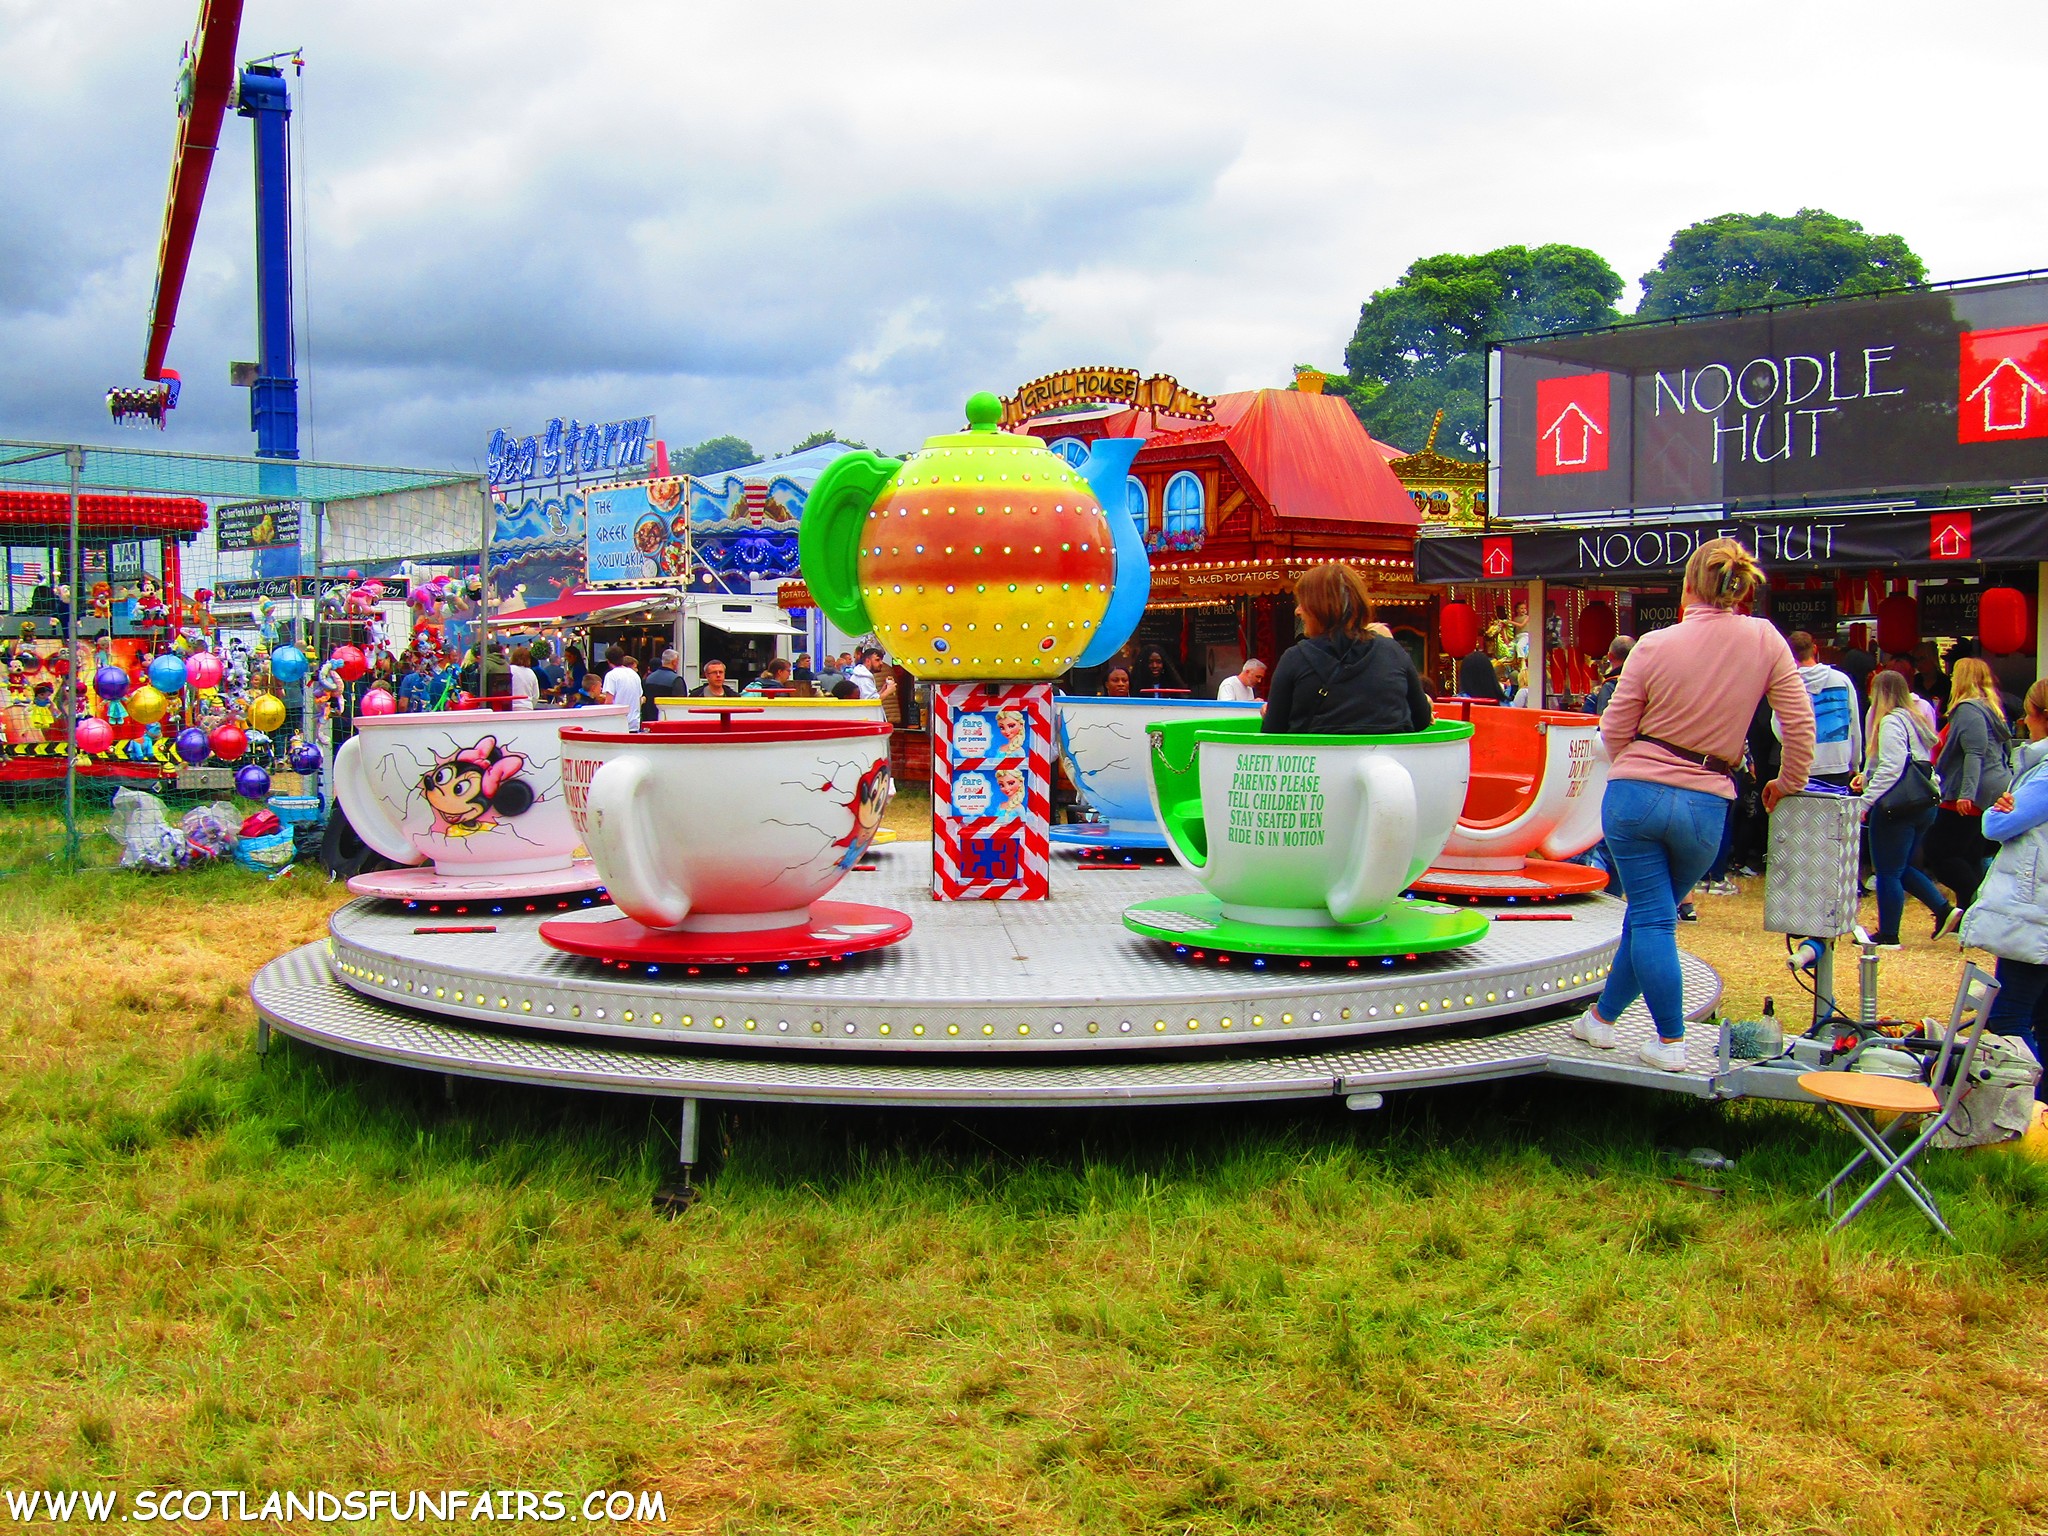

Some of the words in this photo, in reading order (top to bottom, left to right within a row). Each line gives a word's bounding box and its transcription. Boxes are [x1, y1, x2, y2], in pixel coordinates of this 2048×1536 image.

[1654, 345, 1905, 417] NOODLE
[1025, 378, 1073, 408] GRILL
[1076, 375, 1136, 397] HOUSE
[1712, 407, 1838, 464] HUT
[487, 428, 538, 485] Sea
[543, 417, 650, 478] Storm
[595, 500, 612, 514] THE
[596, 524, 628, 542] GREEK
[1754, 523, 1846, 561] HUT
[596, 552, 645, 569] SOUVLAKIA
[1151, 576, 1180, 586] NINI'S
[1188, 574, 1224, 585] BAKED
[1224, 570, 1280, 583] POTATOES
[780, 590, 807, 599] POTATO
[1926, 593, 1946, 605] MIX
[1960, 592, 1980, 605] MAT
[1640, 607, 1679, 621] NOODL
[1778, 601, 1827, 612] NOODLES
[1964, 605, 1978, 618] £8
[962, 718, 983, 728] fare
[1236, 753, 1274, 772] SAFETY
[1275, 755, 1317, 773] NOTICE
[962, 776, 983, 786] fare
[1232, 773, 1278, 792] PARENTS
[1280, 775, 1321, 793] PLEASE
[1228, 791, 1250, 808] TELL
[1253, 793, 1307, 811] CHILDREN
[1310, 794, 1325, 811] TO
[1230, 810, 1255, 827] STAY
[1256, 812, 1297, 829] SEATED
[1300, 812, 1323, 829] WEN
[1228, 827, 1252, 844] RIDE
[1255, 830, 1265, 846] IS
[1268, 831, 1280, 847] IN
[1282, 830, 1326, 847] MOTION
[960, 838, 1018, 879] £3
